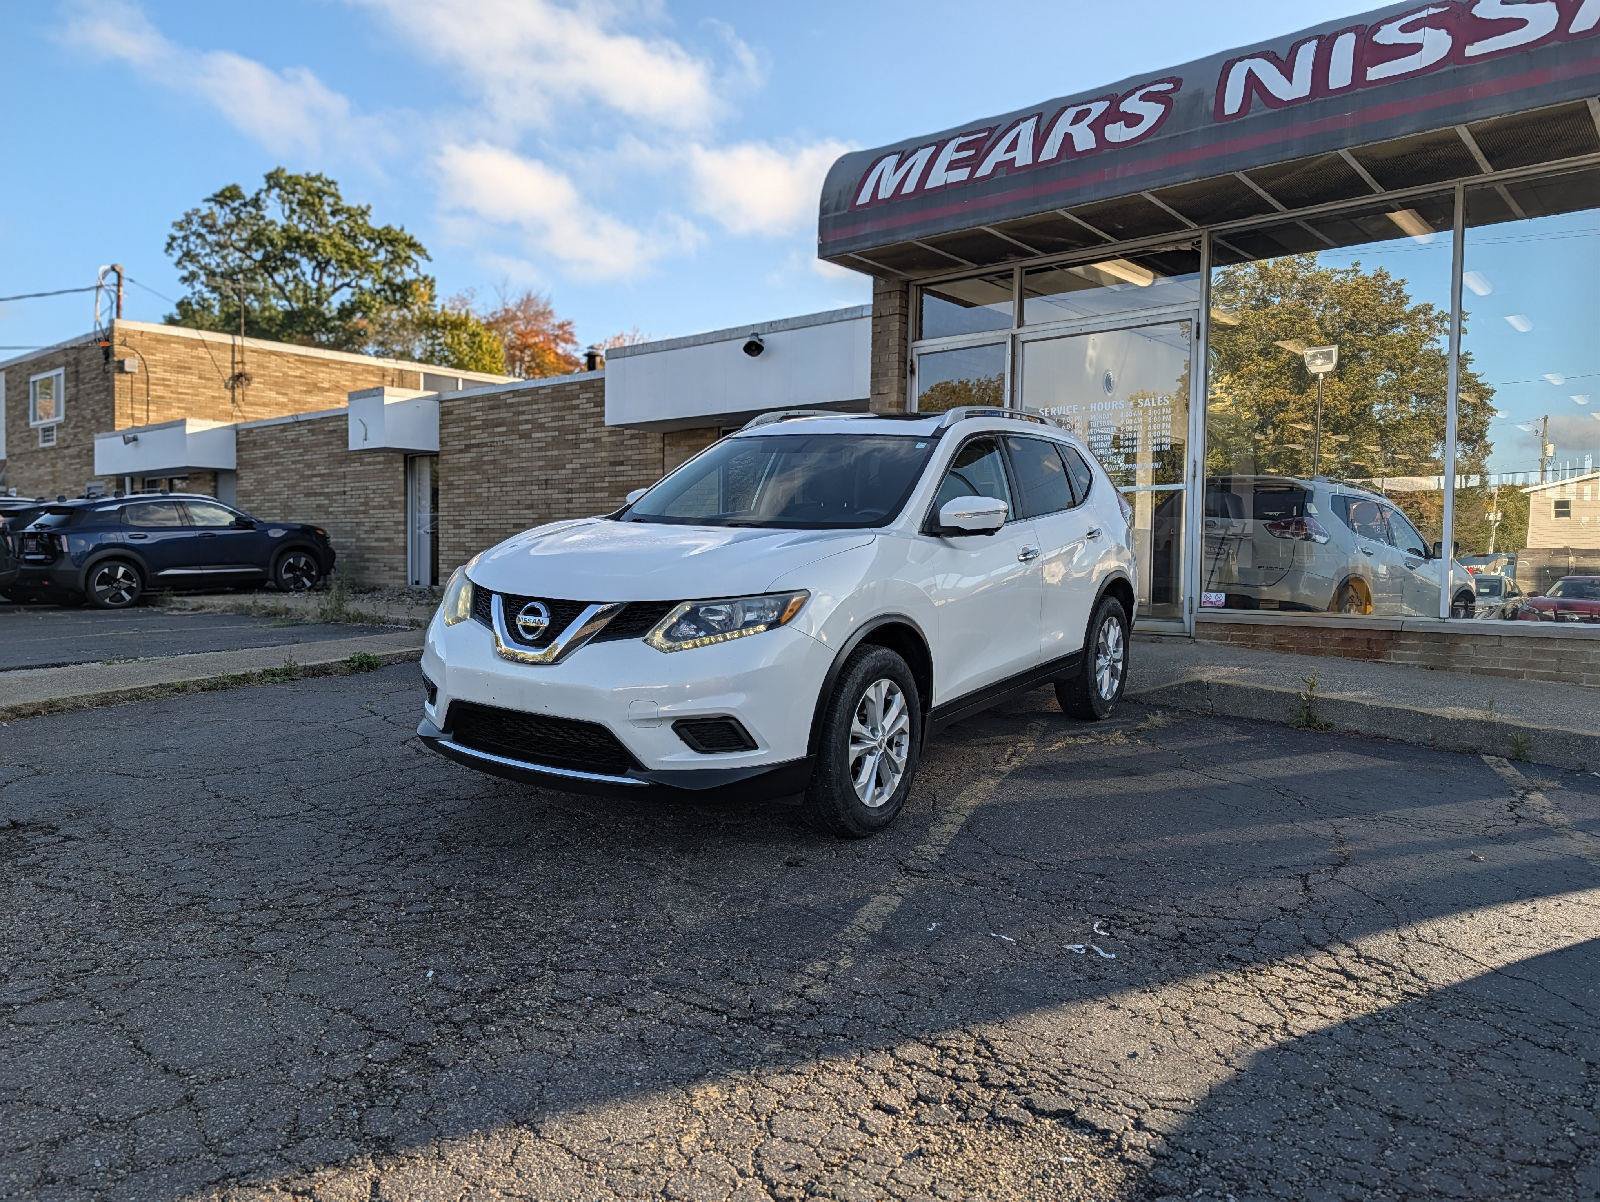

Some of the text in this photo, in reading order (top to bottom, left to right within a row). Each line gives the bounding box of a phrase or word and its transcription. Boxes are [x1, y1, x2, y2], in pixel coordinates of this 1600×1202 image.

[855, 82, 1176, 207] MEARS
[1038, 396, 1170, 417] SERVICE HOURS SALES
[517, 617, 544, 625] NISSAN
